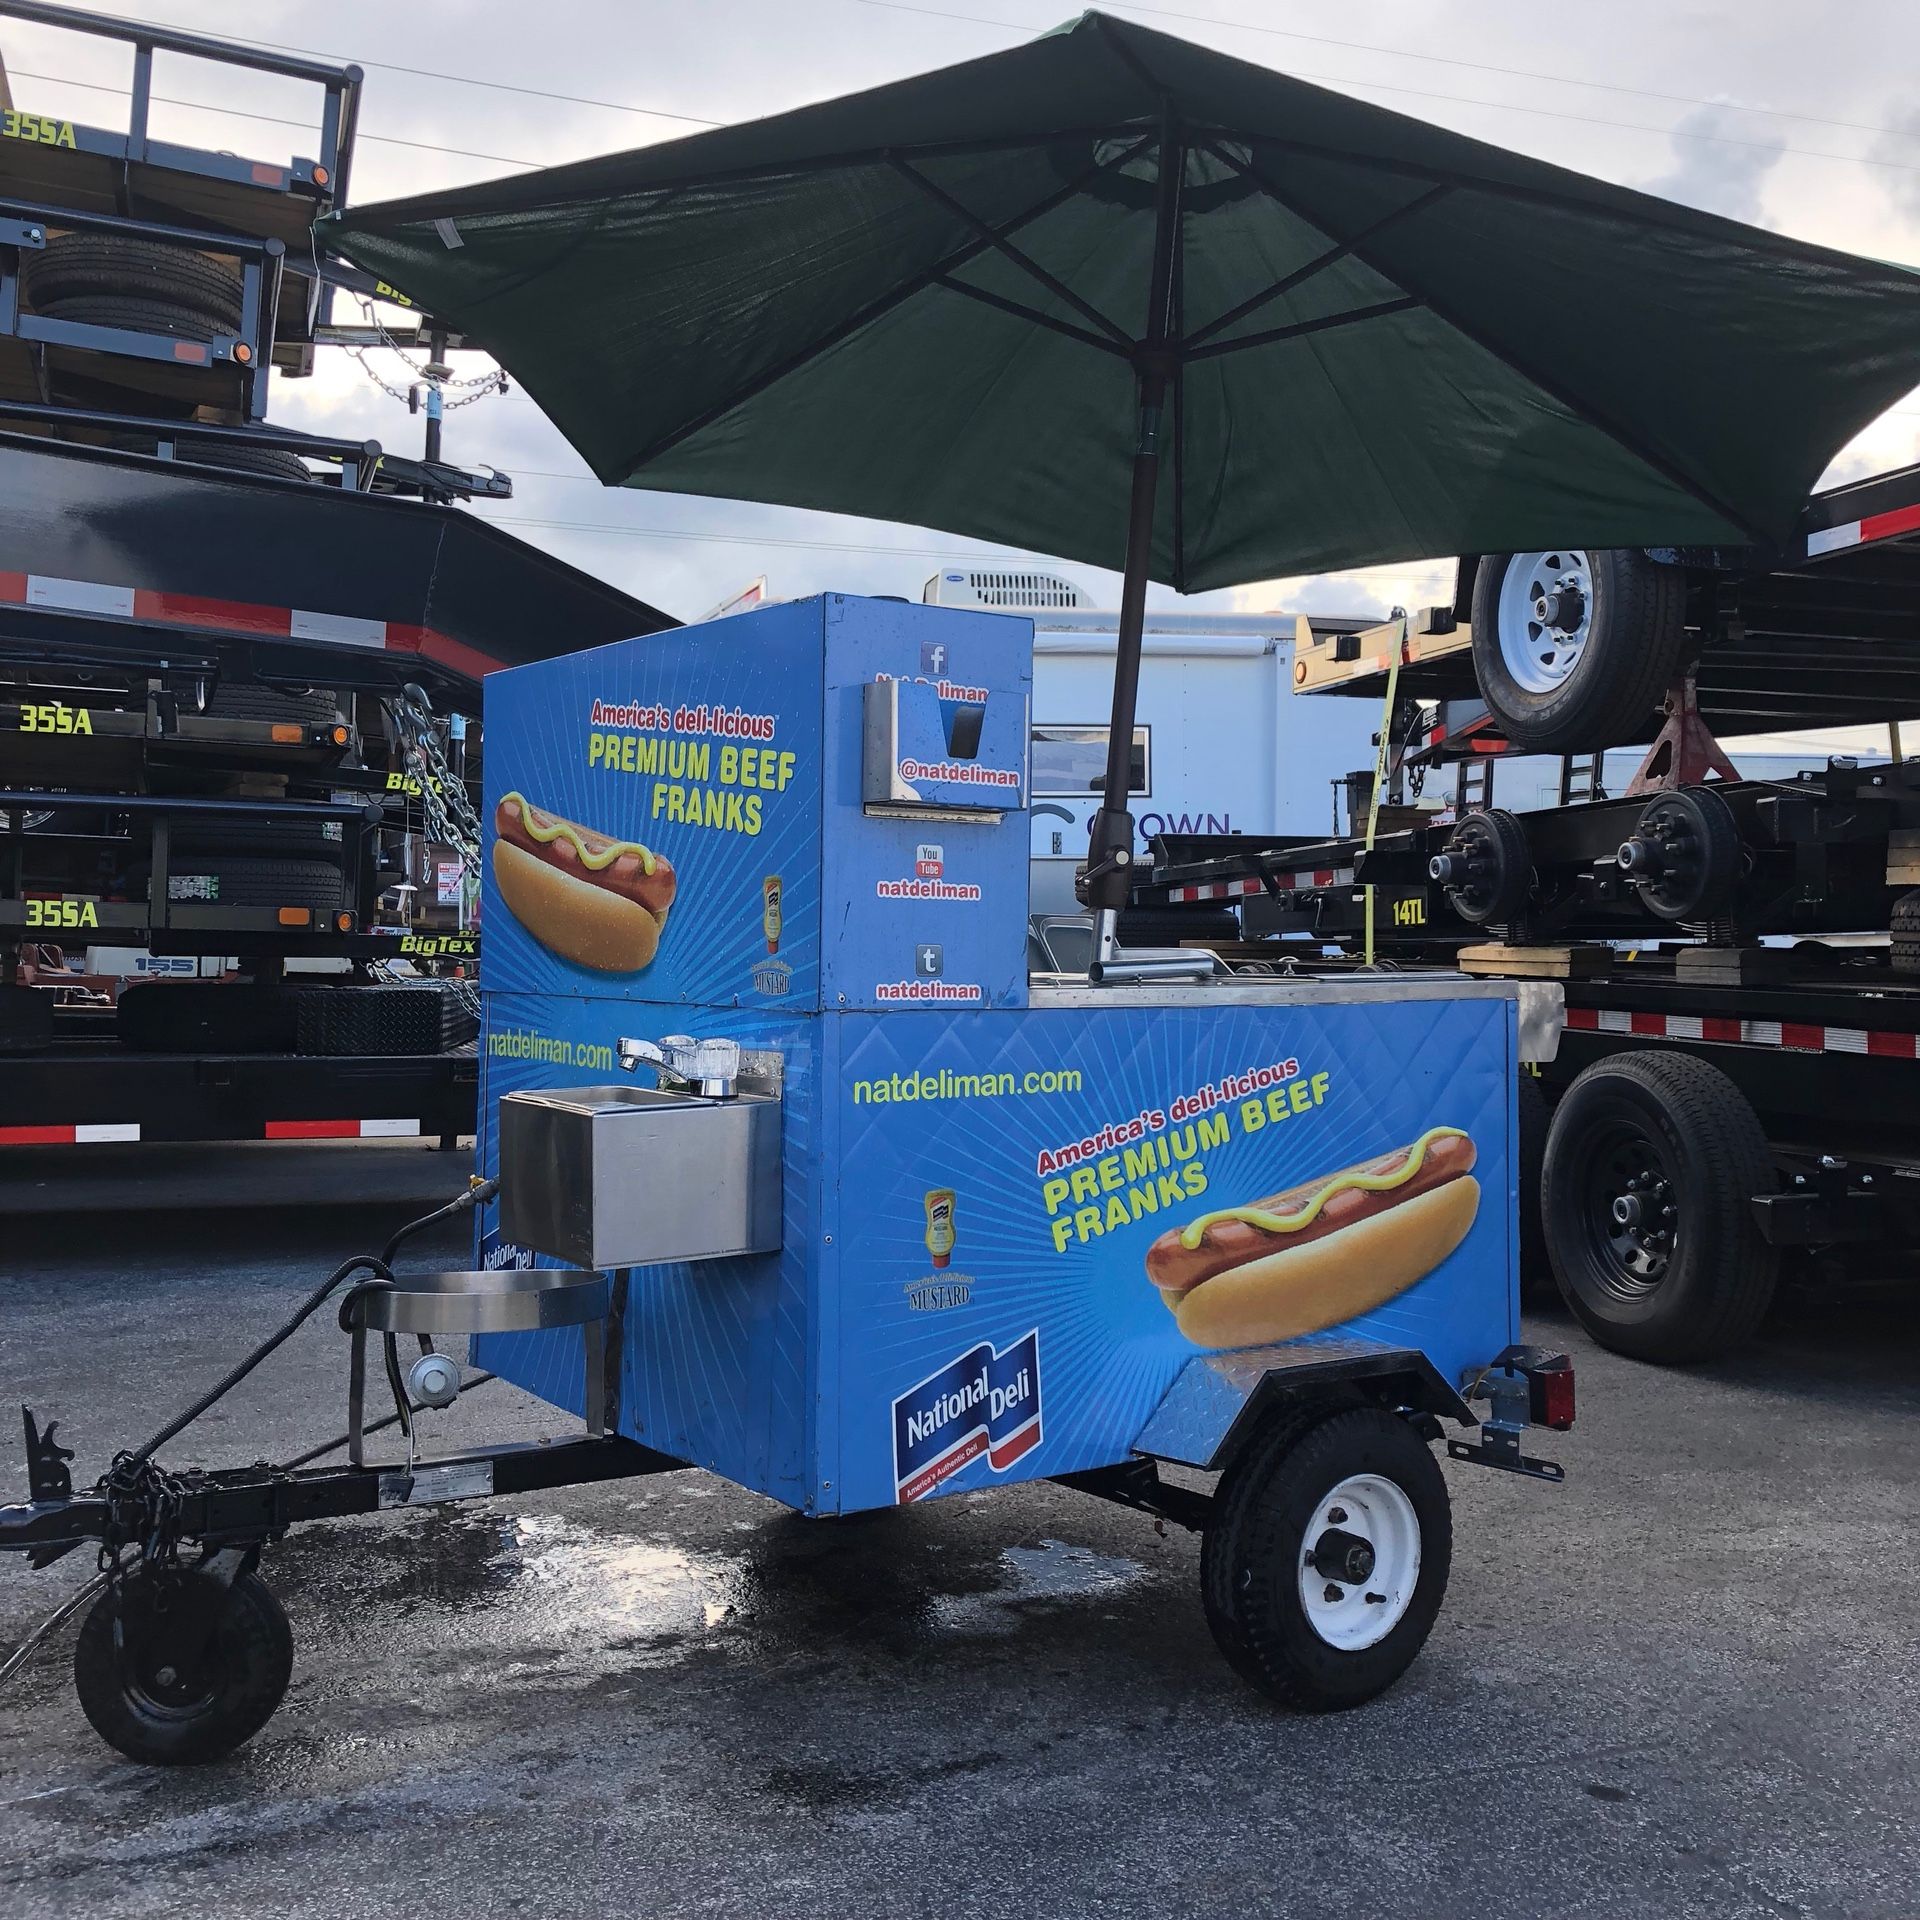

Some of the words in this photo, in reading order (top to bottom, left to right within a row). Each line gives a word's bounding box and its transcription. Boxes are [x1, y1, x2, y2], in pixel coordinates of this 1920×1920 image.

[3, 109, 77, 149] 35SA
[931, 646, 944, 673] f
[20, 704, 94, 735] 35SA
[592, 698, 671, 732] America's
[674, 704, 774, 741] deli-licious
[589, 733, 710, 781] PREMIUM
[720, 746, 796, 792] BEEF
[899, 759, 1021, 787] @natdeliman
[652, 783, 762, 835] FRANKS
[1087, 813, 1230, 840] OWN
[922, 847, 938, 860] You
[920, 862, 939, 875] Tube
[877, 879, 981, 900] natdeliman
[26, 900, 99, 927] 35SA
[1393, 899, 1426, 926] 14TL
[400, 936, 475, 957] BigTex
[923, 948, 936, 973] t
[135, 958, 194, 972] 155
[876, 980, 981, 1001] natdeliman
[488, 1028, 612, 1071] natdeliman.com
[854, 1069, 1082, 1105] natdeliman.com
[1038, 1109, 1166, 1178] America's
[1169, 1057, 1299, 1123] deli-licious
[1043, 1112, 1231, 1216] PREMIUM
[1241, 1071, 1330, 1133] BEEF
[1051, 1162, 1209, 1253] FRANKS
[910, 1285, 971, 1311] MUSTARD
[906, 1366, 990, 1449] National
[990, 1368, 1030, 1422] Deli
[906, 1471, 937, 1499] America's
[937, 1453, 966, 1478] Authentic
[965, 1442, 979, 1456] Deli
